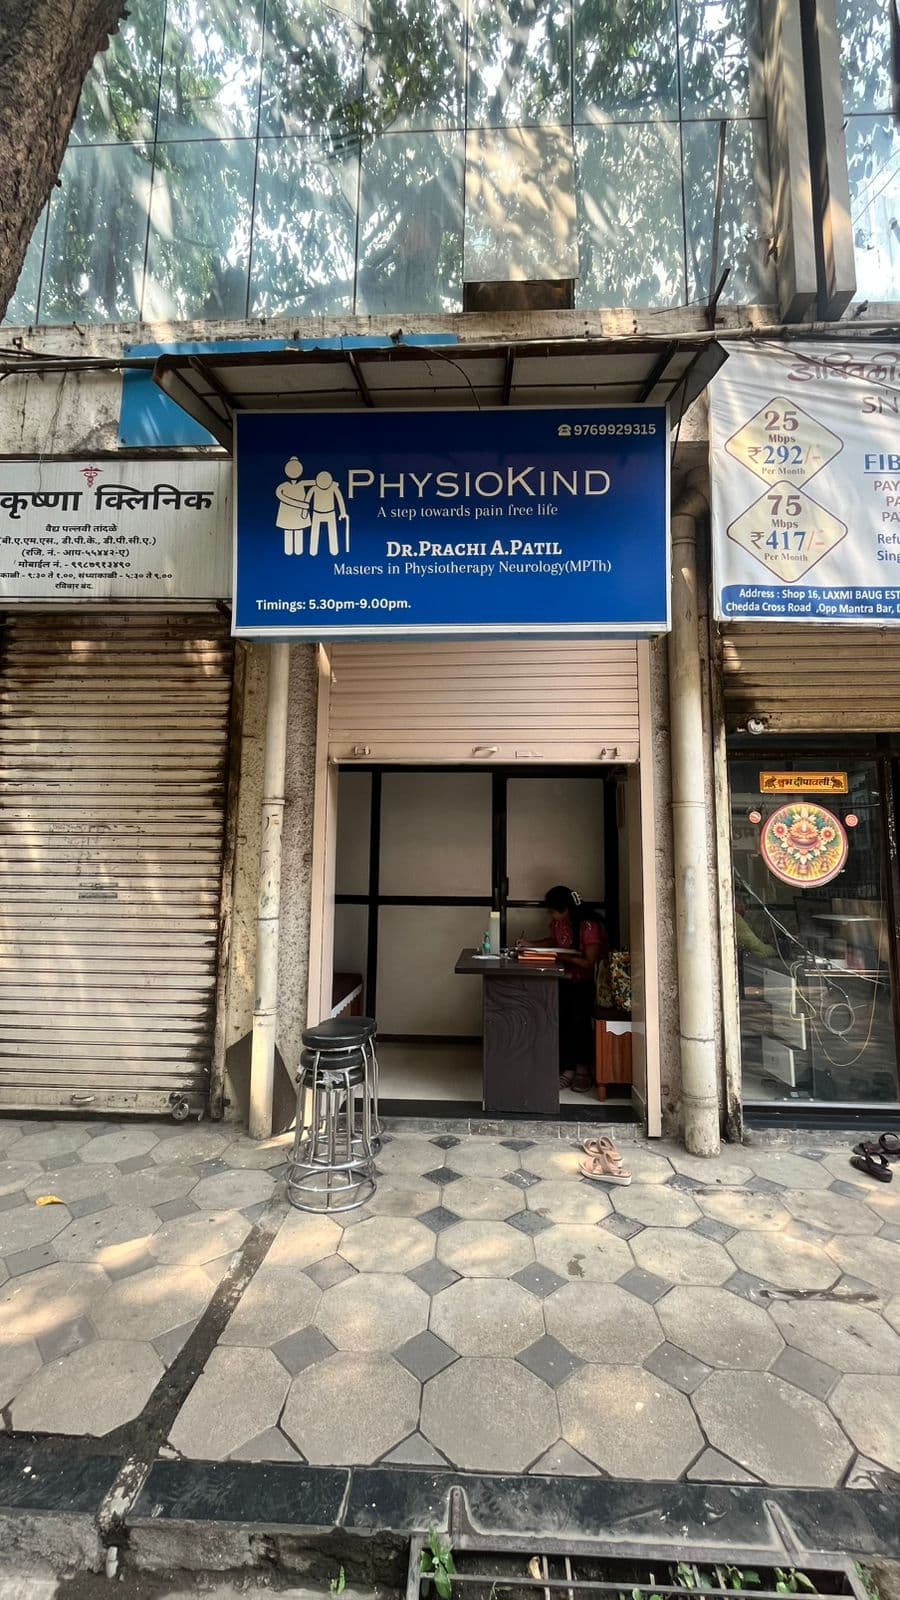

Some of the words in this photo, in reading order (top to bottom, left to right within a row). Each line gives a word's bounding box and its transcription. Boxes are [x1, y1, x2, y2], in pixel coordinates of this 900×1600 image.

[764, 410, 799, 432] 25
[573, 423, 657, 436] 9769929315
[768, 434, 797, 445] Mbps
[762, 467, 778, 475] Per
[779, 467, 806, 475] Month
[95, 484, 214, 511] क्लिनिक
[377, 506, 387, 518] A
[390, 506, 417, 521] step
[420, 504, 471, 518] towards
[475, 505, 503, 520] pain
[508, 503, 534, 517] free
[537, 503, 558, 517] life
[767, 495, 802, 517] 75
[771, 519, 800, 530] Mbps
[764, 553, 779, 561] Per
[781, 553, 808, 562] Month
[333, 562, 384, 576] Masters
[388, 562, 400, 575] in
[405, 561, 495, 578] Physiotherapy
[498, 560, 612, 577] Neurology(MPTh)
[739, 589, 775, 599] Address
[782, 589, 806, 601] Shop
[808, 590, 821, 600] 16,
[823, 590, 853, 600] LAXMI
[855, 590, 883, 600] BAUG
[256, 599, 306, 613] Timings:
[309, 598, 412, 612] 5.30pm-9.00pm.
[726, 603, 760, 612] Chedda
[762, 603, 786, 613] Cross
[787, 603, 812, 613] Road
[839, 603, 874, 614] Mantra
[876, 603, 895, 614] Bar,
[793, 777, 830, 787] दीपावली
